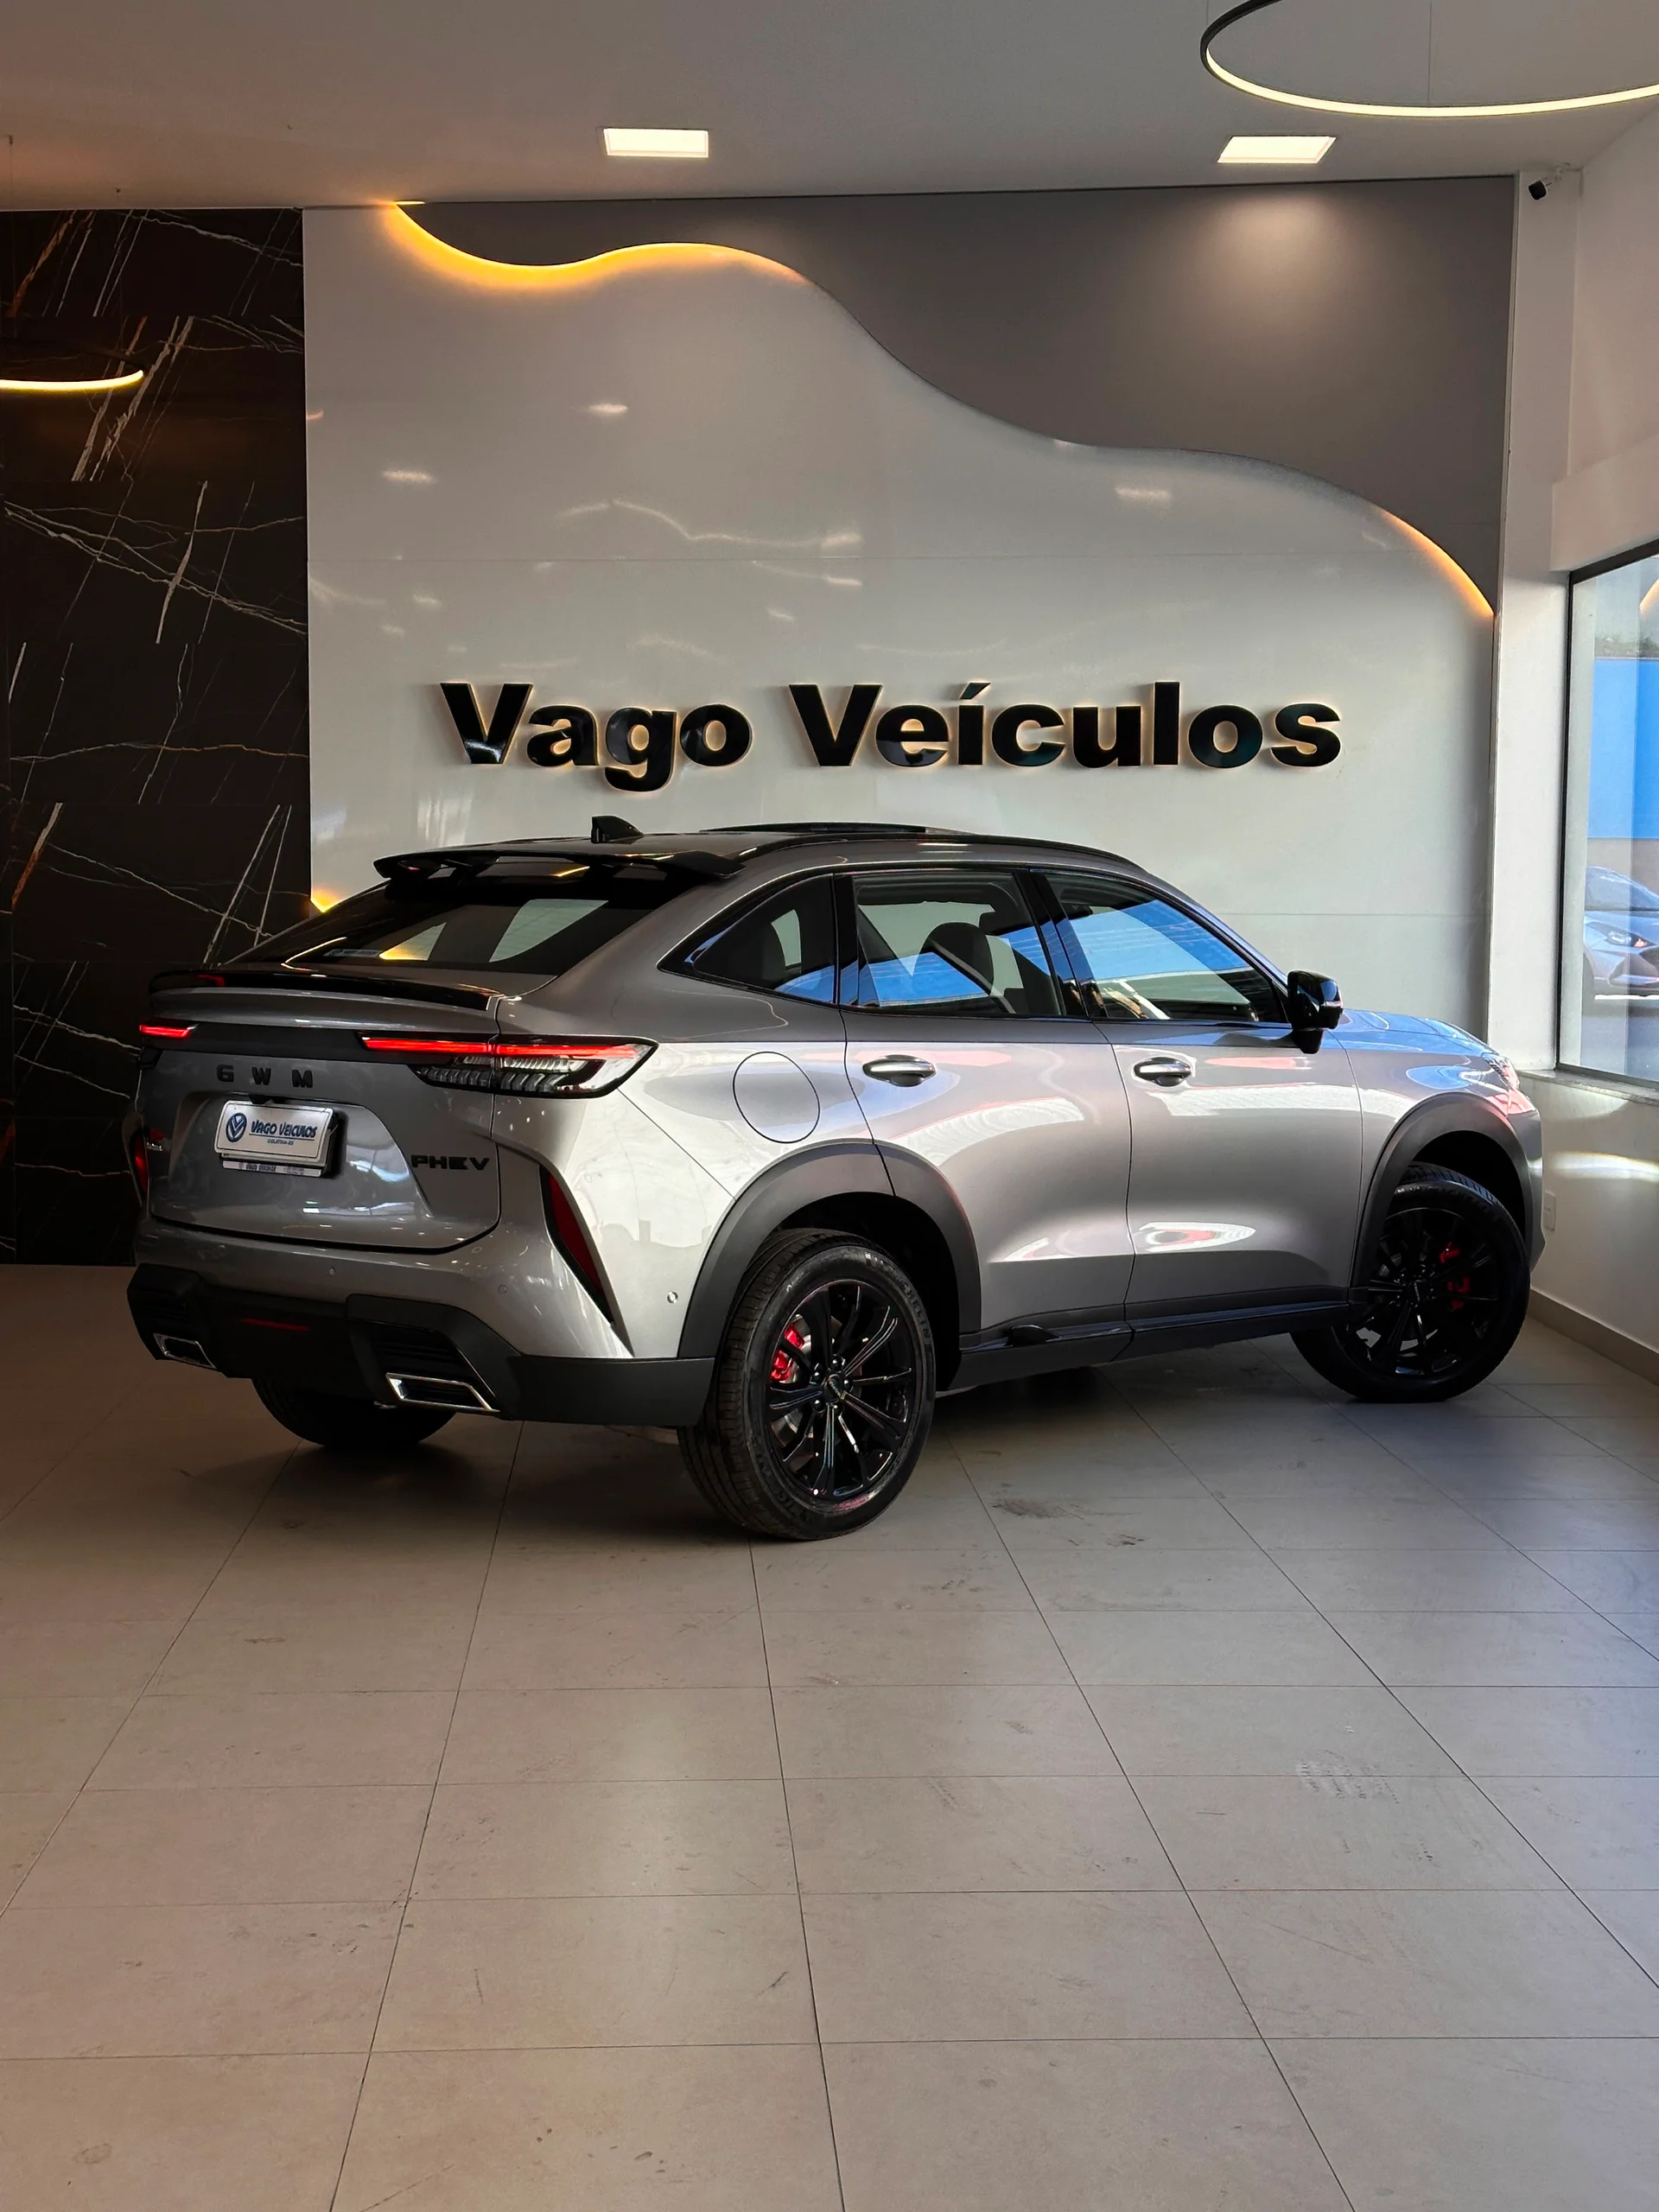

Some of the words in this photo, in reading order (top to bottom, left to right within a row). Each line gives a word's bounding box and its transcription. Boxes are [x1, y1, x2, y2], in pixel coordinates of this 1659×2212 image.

[440, 683, 752, 791] Vago
[788, 680, 1341, 769] Veículos
[251, 1120, 277, 1135] VAGO
[410, 1154, 492, 1172] PHEV
